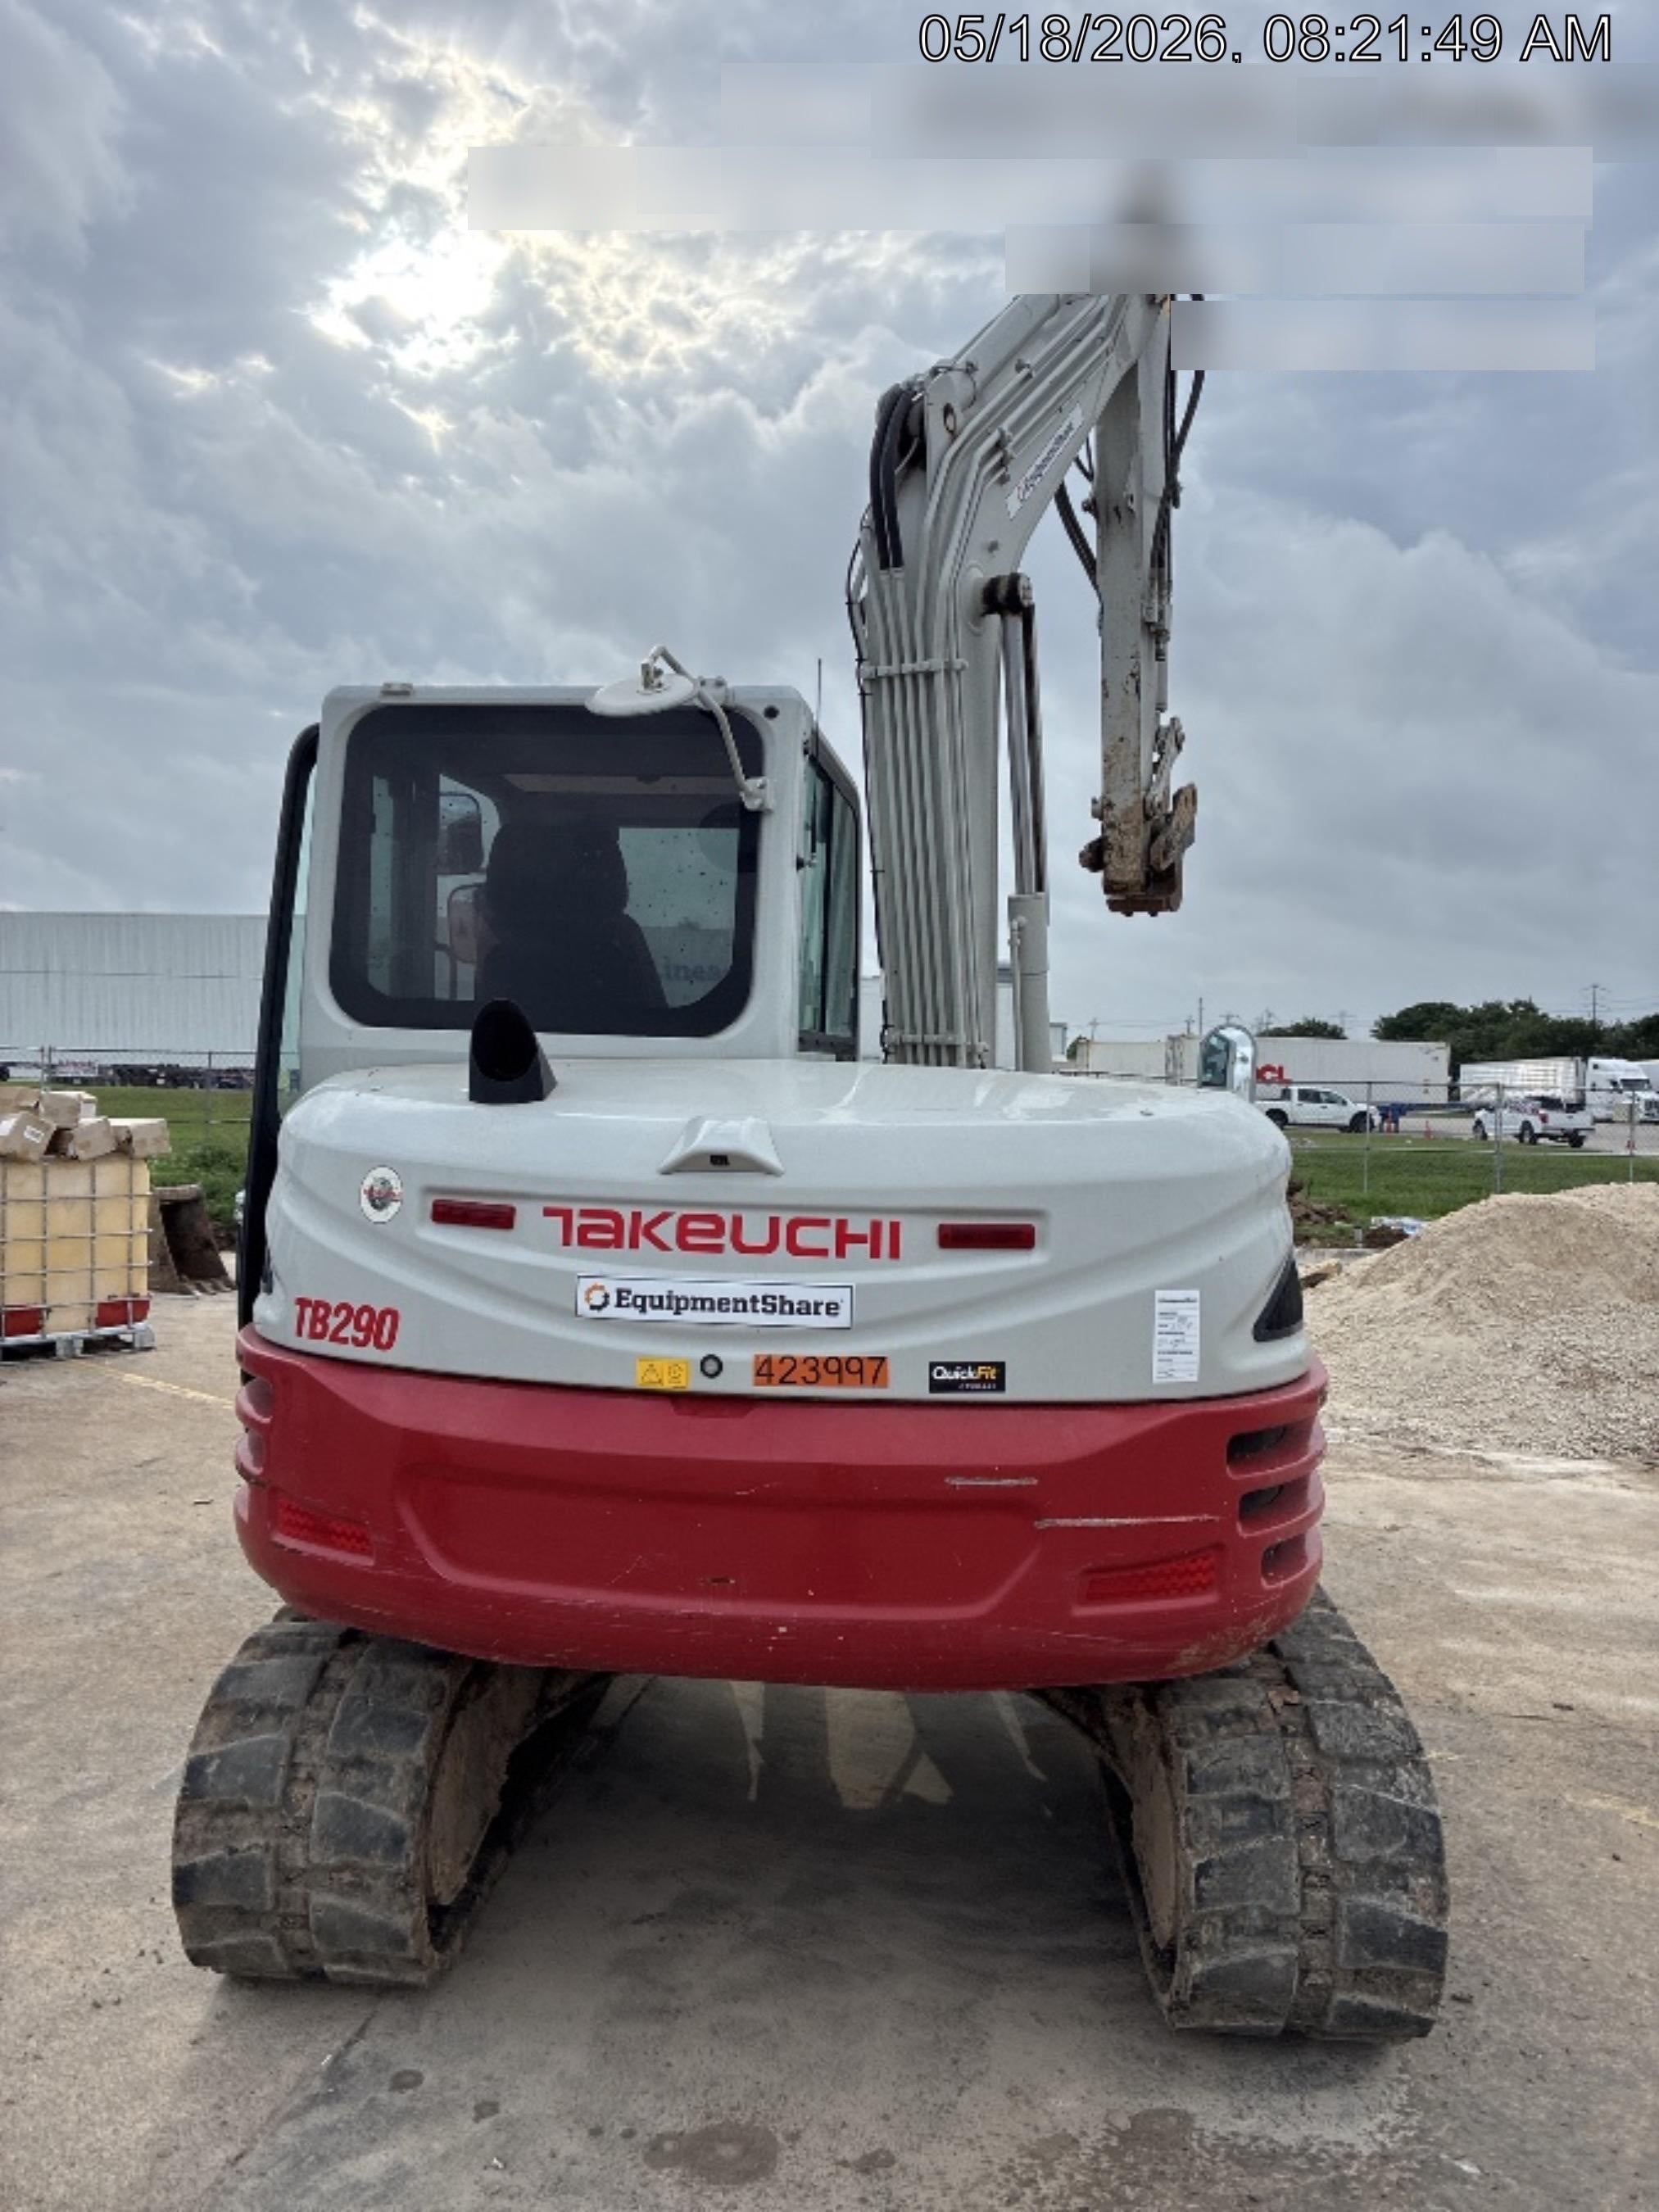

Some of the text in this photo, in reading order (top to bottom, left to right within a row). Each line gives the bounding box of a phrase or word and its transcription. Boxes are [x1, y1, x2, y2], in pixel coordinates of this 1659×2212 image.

[614, 1287, 841, 1317] EquipmentShare
[295, 1298, 399, 1350] TB290
[755, 1356, 887, 1385] 423997
[932, 1364, 997, 1380] QuickFit
